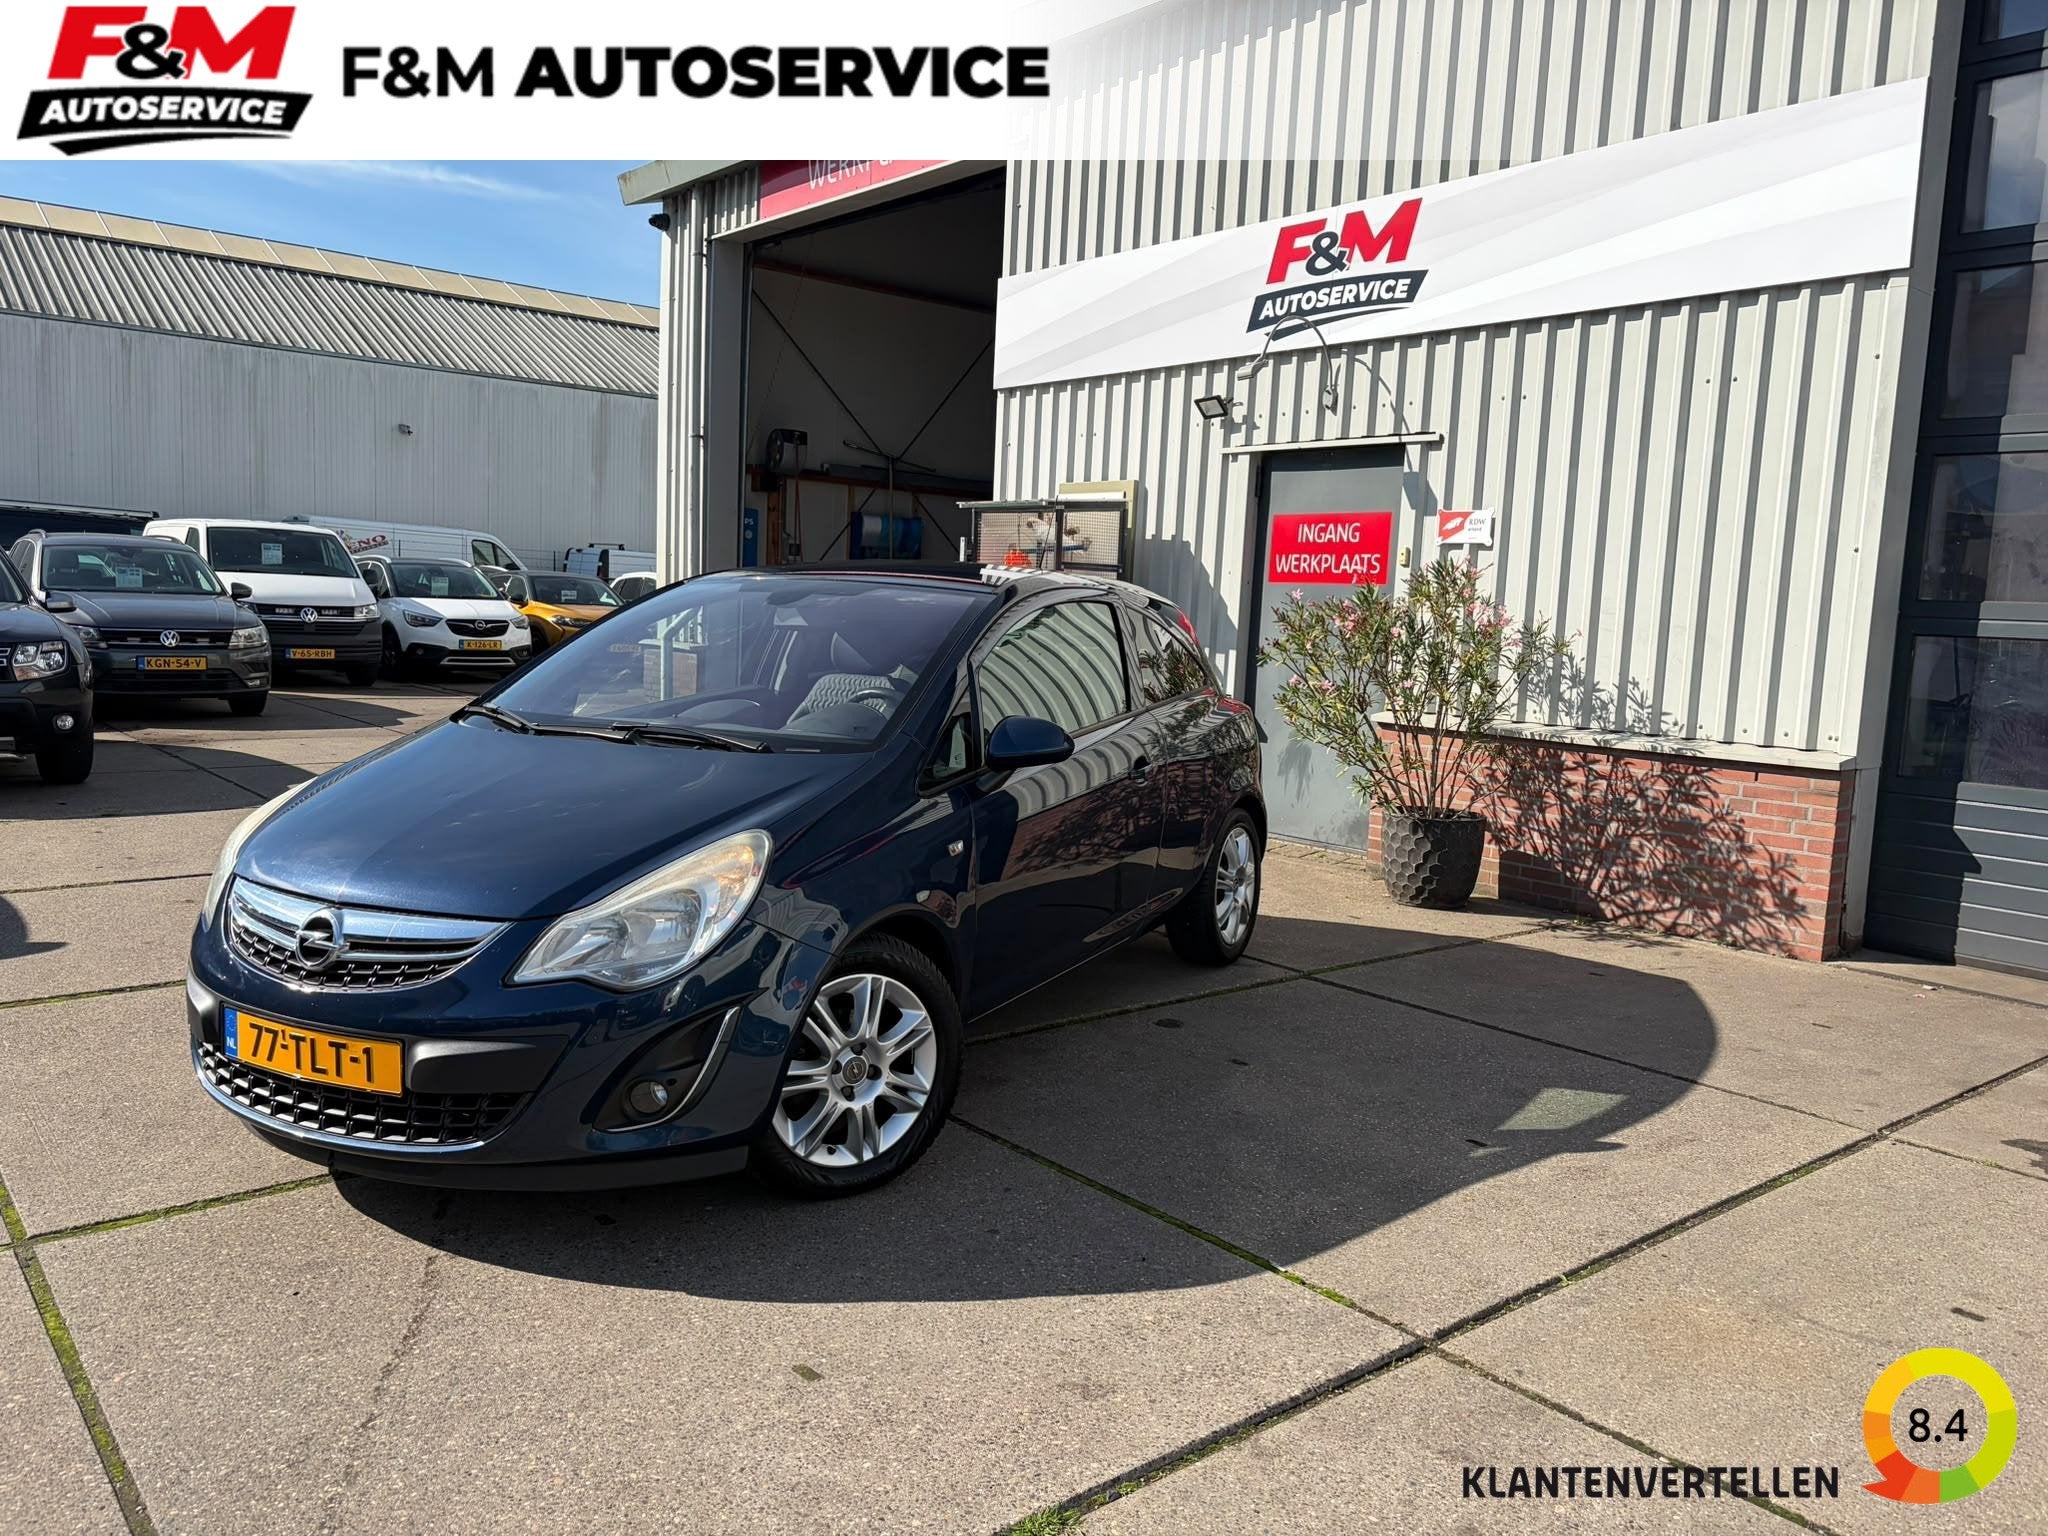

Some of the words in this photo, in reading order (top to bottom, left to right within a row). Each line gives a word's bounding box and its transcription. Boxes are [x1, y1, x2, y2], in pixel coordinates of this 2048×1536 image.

[1266, 197, 1423, 285] F&M
[1259, 277, 1411, 321] AUTOSERVICE
[1298, 522, 1361, 543] INGANG
[1275, 553, 1381, 575] WERKPLAATS
[146, 657, 202, 668] KGN-54-V
[226, 1035, 237, 1050] NL
[249, 1021, 374, 1084] 77-TLT-1
